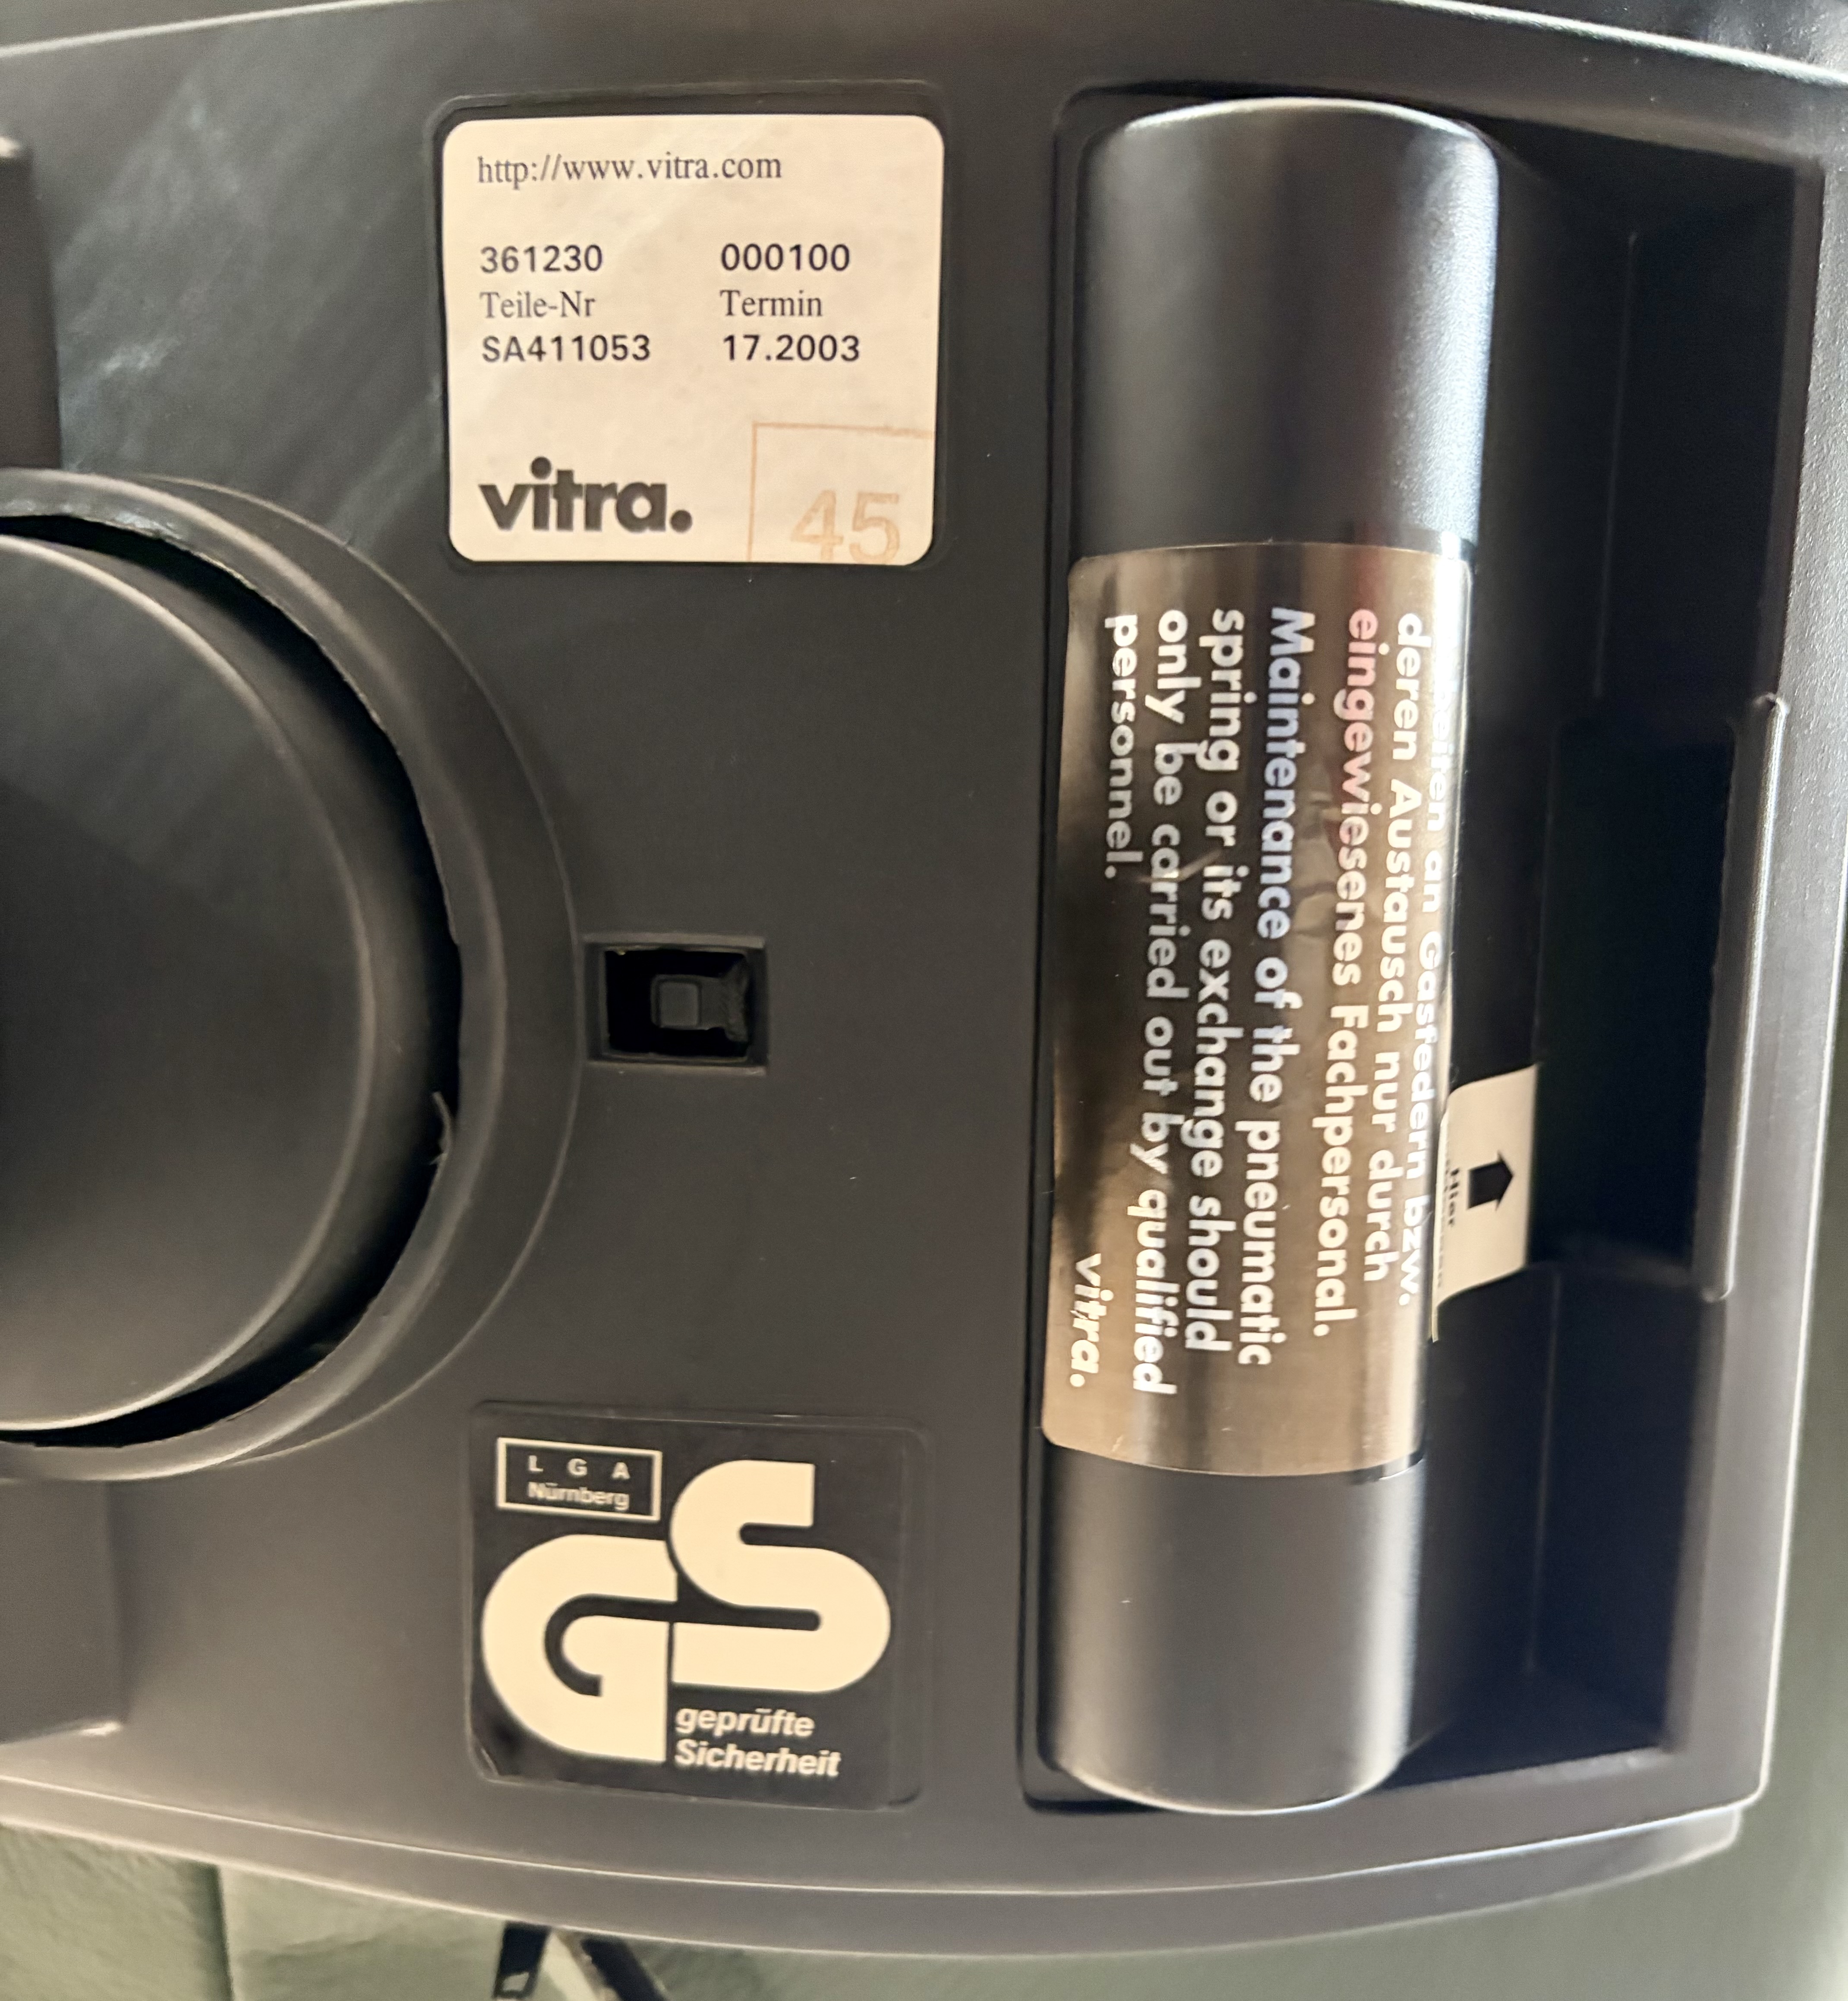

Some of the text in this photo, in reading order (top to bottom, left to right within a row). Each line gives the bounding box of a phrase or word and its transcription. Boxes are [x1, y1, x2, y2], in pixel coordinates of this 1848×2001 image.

[477, 152, 782, 190] http://www.vitra.com
[480, 244, 603, 273] 361230
[721, 243, 850, 271] 000100
[479, 290, 595, 318] Teile-Nr
[719, 290, 823, 317] Termin
[481, 334, 651, 362] SA411053
[722, 334, 860, 361] 17.2003
[479, 456, 693, 533] vitra.
[791, 489, 900, 563] 45
[1104, 613, 1144, 878] personnel.
[1312, 609, 1389, 1336] eingewiesenes Fachpersonal.
[1364, 612, 1431, 1281] deren Austausch nur durch
[1398, 617, 1459, 1305] beiten an Gasfedern bzw.
[1128, 609, 1202, 1394] only be carried out by qualified
[1180, 608, 1257, 1351] spring or its exchange should
[1236, 607, 1316, 1364] Maintenance of the pneumatic
[1069, 1253, 1113, 1388] vitra.
[527, 1482, 630, 1511] Nürnberg
[675, 1708, 814, 1736] geprüfte
[675, 1739, 841, 1776] Sicherheit
